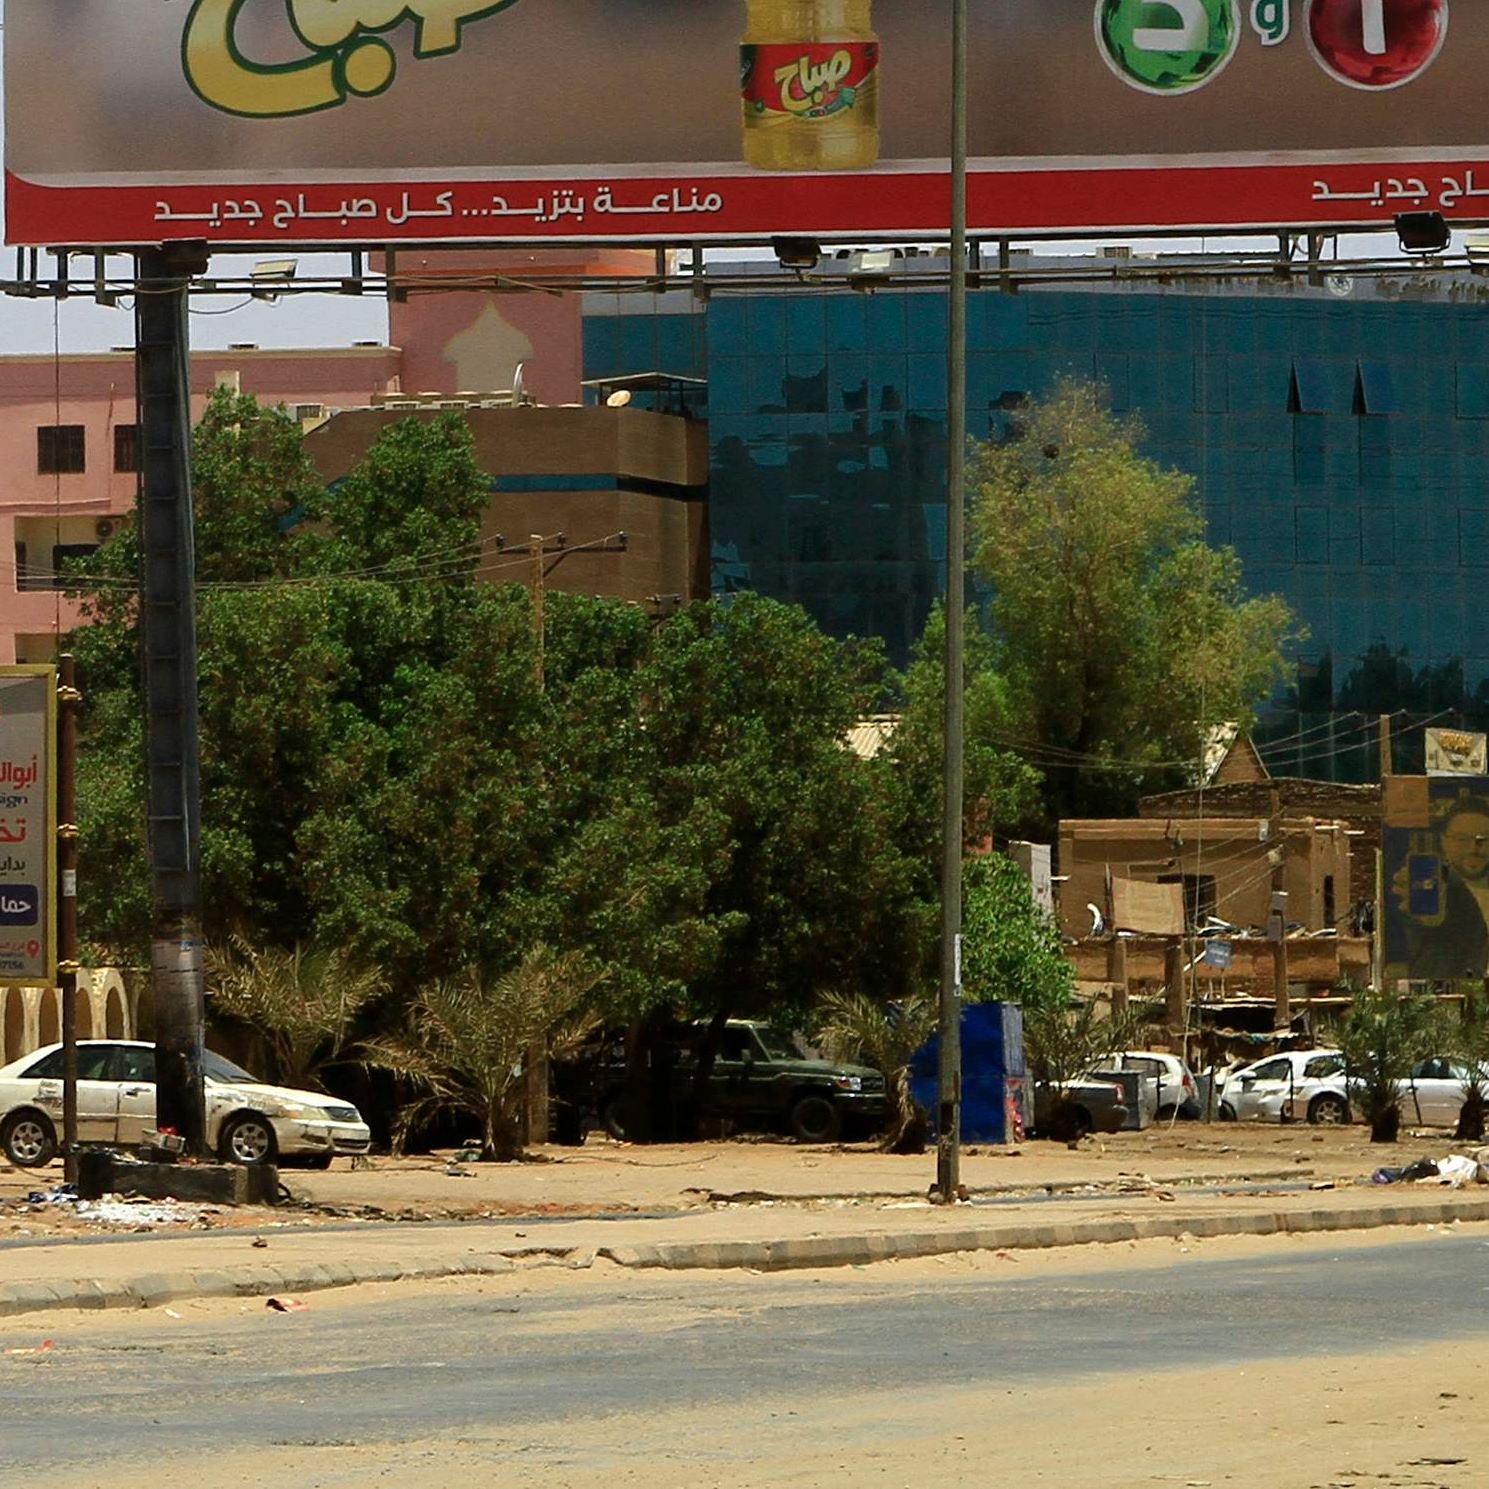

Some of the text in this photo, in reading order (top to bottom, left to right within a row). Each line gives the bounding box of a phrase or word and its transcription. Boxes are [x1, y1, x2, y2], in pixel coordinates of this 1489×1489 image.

[774, 49, 852, 112] صباح
[593, 187, 722, 213] مناعة
[1312, 170, 1489, 207] اح جديد
[154, 199, 263, 227] جديد
[273, 193, 377, 229] صباح
[386, 191, 453, 224] كل
